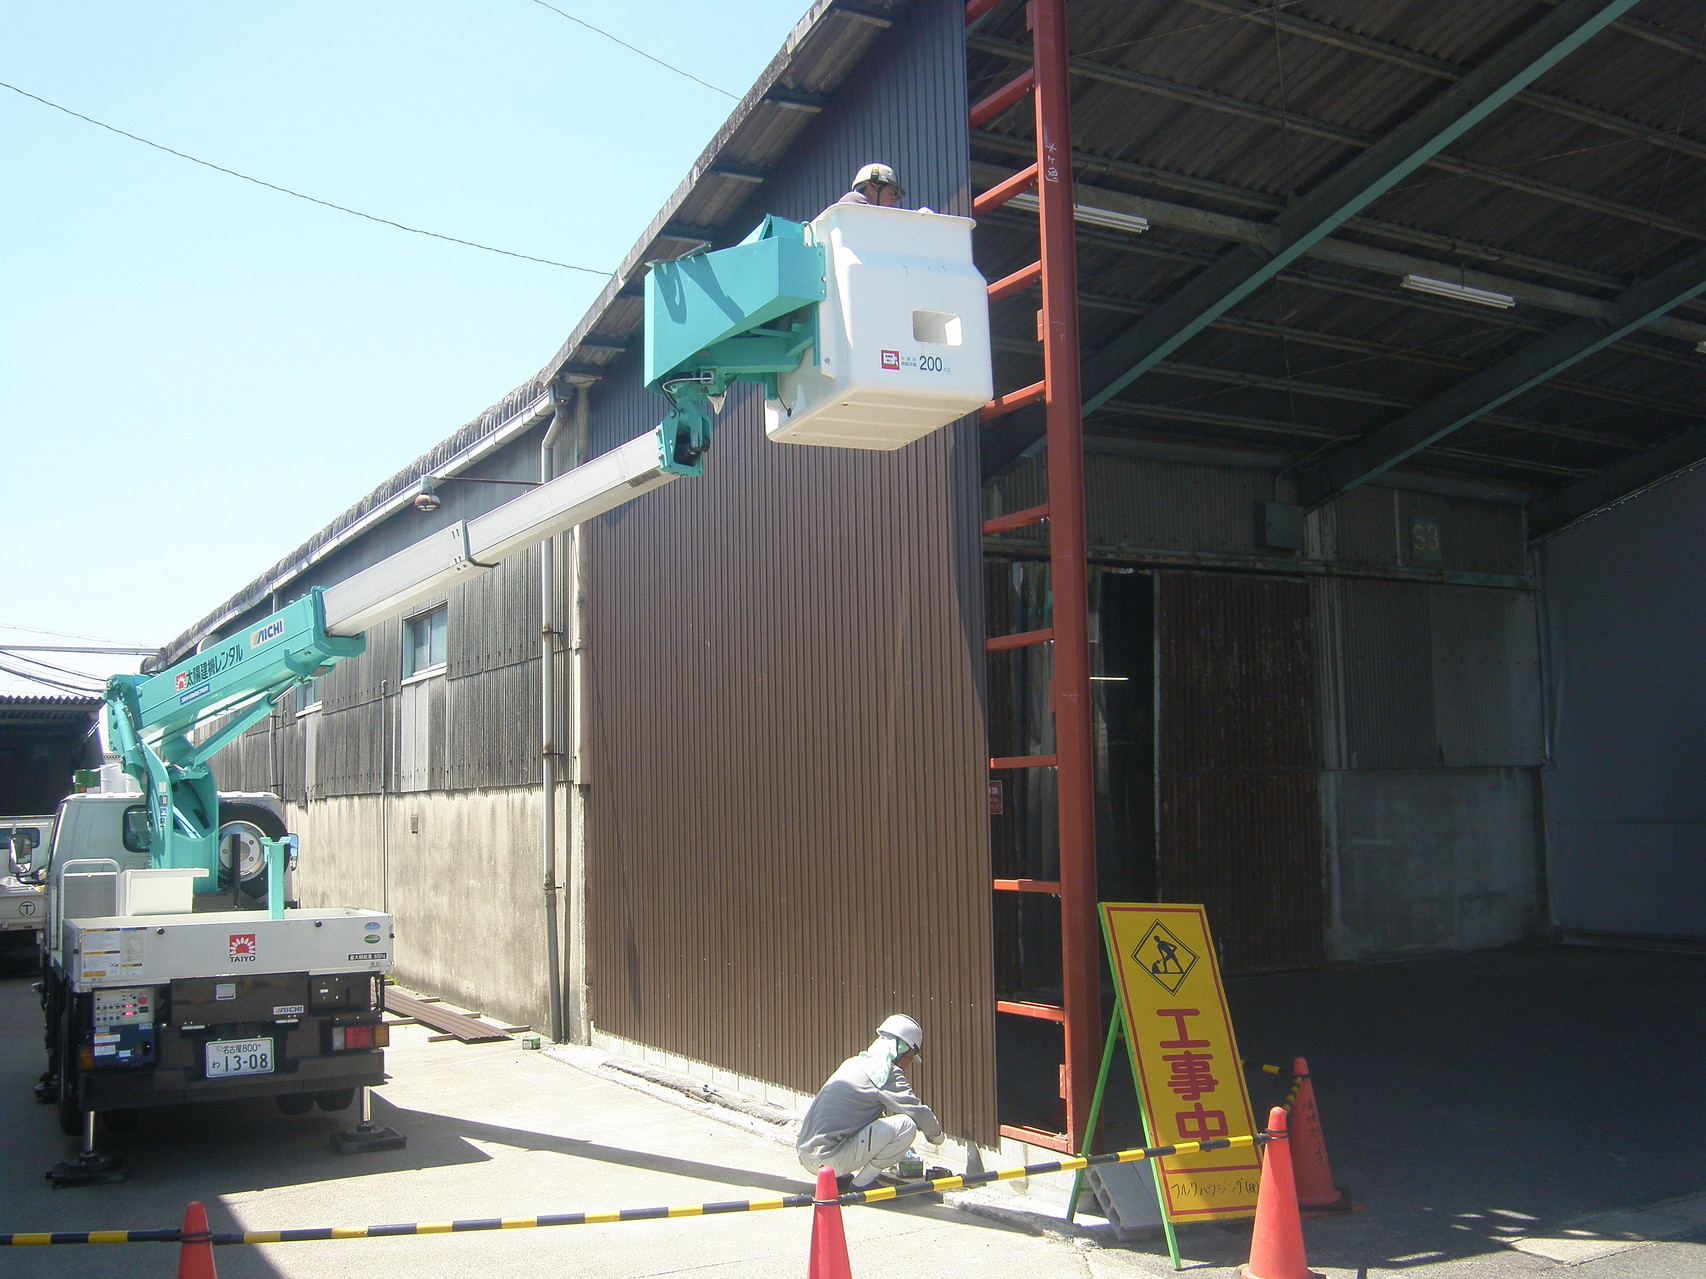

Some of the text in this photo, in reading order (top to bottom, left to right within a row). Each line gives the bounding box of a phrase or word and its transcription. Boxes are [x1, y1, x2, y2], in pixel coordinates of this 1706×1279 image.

[1412, 524, 1438, 550] S3
[256, 620, 283, 645] AICHI
[186, 644, 244, 688] 太陽建機レンタル
[229, 955, 256, 963] TAIYO
[225, 1053, 269, 1072] 13-08
[1156, 1008, 1229, 1153] 工事中
